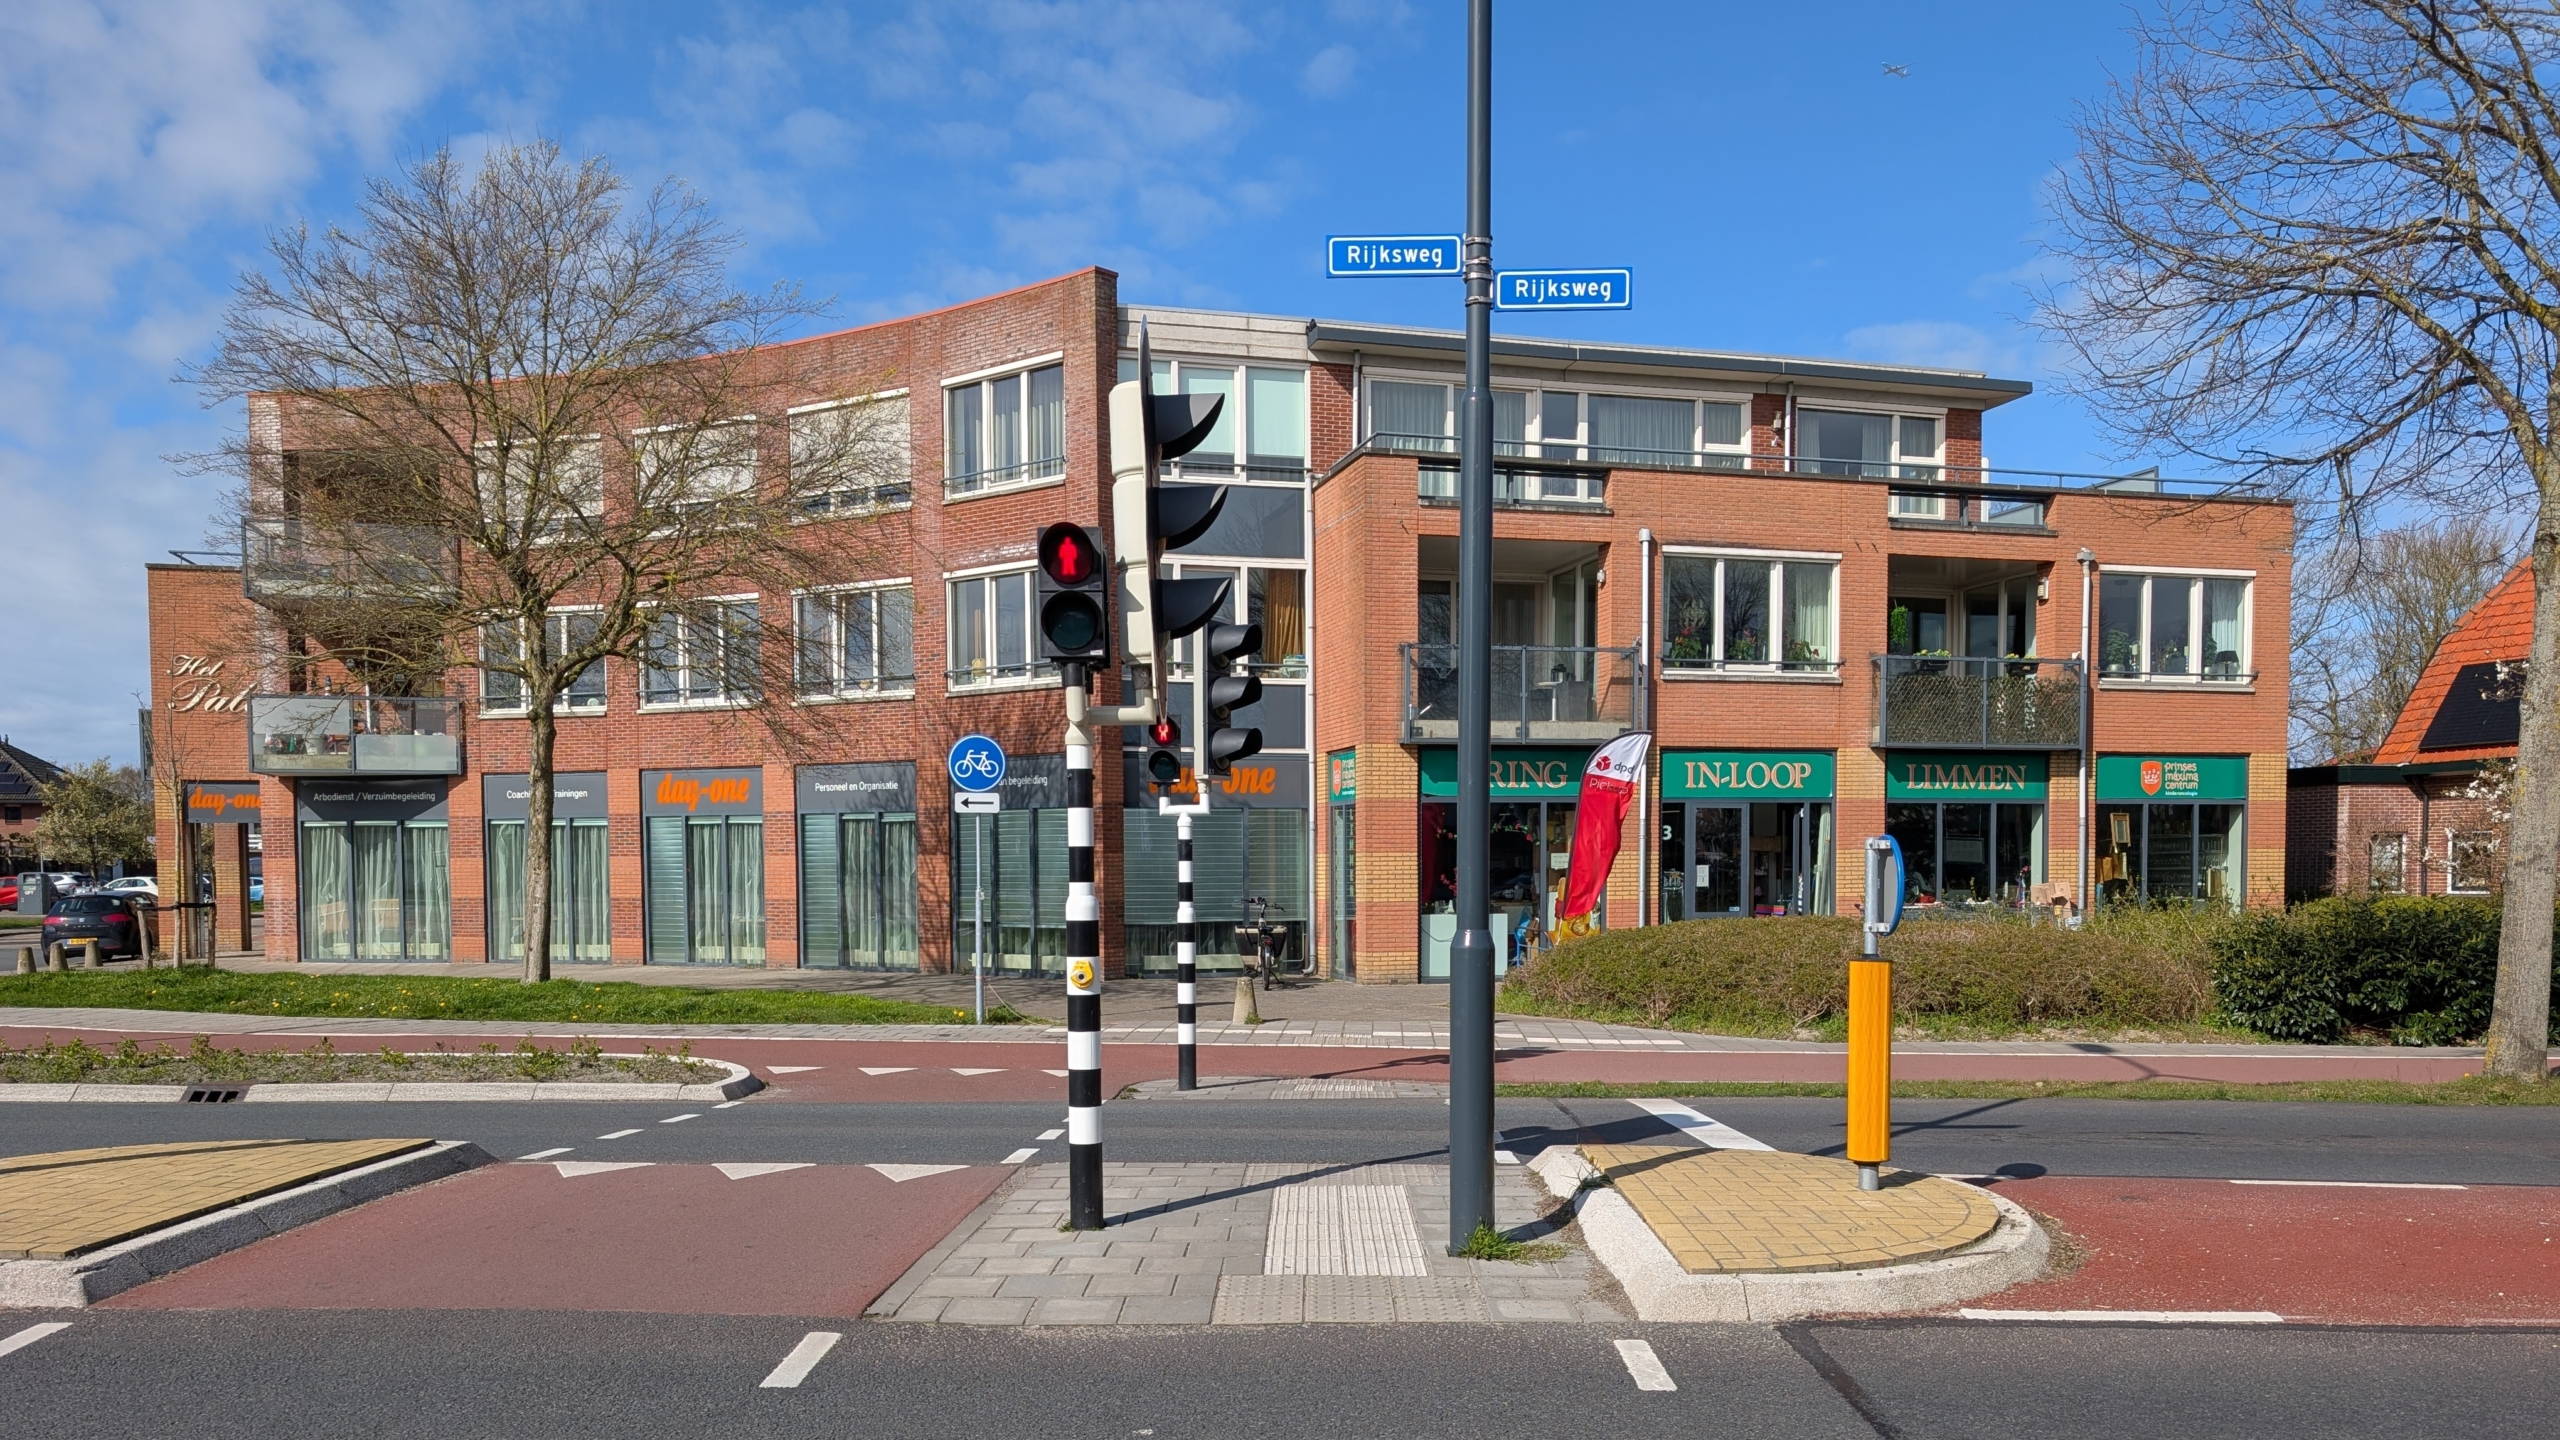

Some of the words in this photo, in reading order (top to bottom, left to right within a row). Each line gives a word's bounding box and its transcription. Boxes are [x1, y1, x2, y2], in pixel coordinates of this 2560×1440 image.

[1347, 244, 1442, 269] Rijksweg
[1515, 279, 1611, 303] Rijksweg
[166, 654, 225, 676] Het
[167, 677, 257, 713] Pal
[1489, 760, 1569, 789] RING
[1613, 761, 1636, 775] dpd
[1684, 761, 1812, 789] IN-LOOP
[1906, 763, 2027, 790] LIMMEN
[2163, 761, 2197, 773] prinses
[814, 782, 848, 792] Personeel
[849, 783, 858, 791] en
[859, 781, 899, 792] Organisatie
[1008, 775, 1048, 788] begeleiding
[1589, 777, 1629, 796] Pickup
[2164, 781, 2199, 790] centrum
[313, 792, 354, 801] Arbodienst
[362, 791, 435, 802] Verzuimbegeleiding
[506, 790, 530, 799] Coachi
[656, 772, 750, 812] day-one
